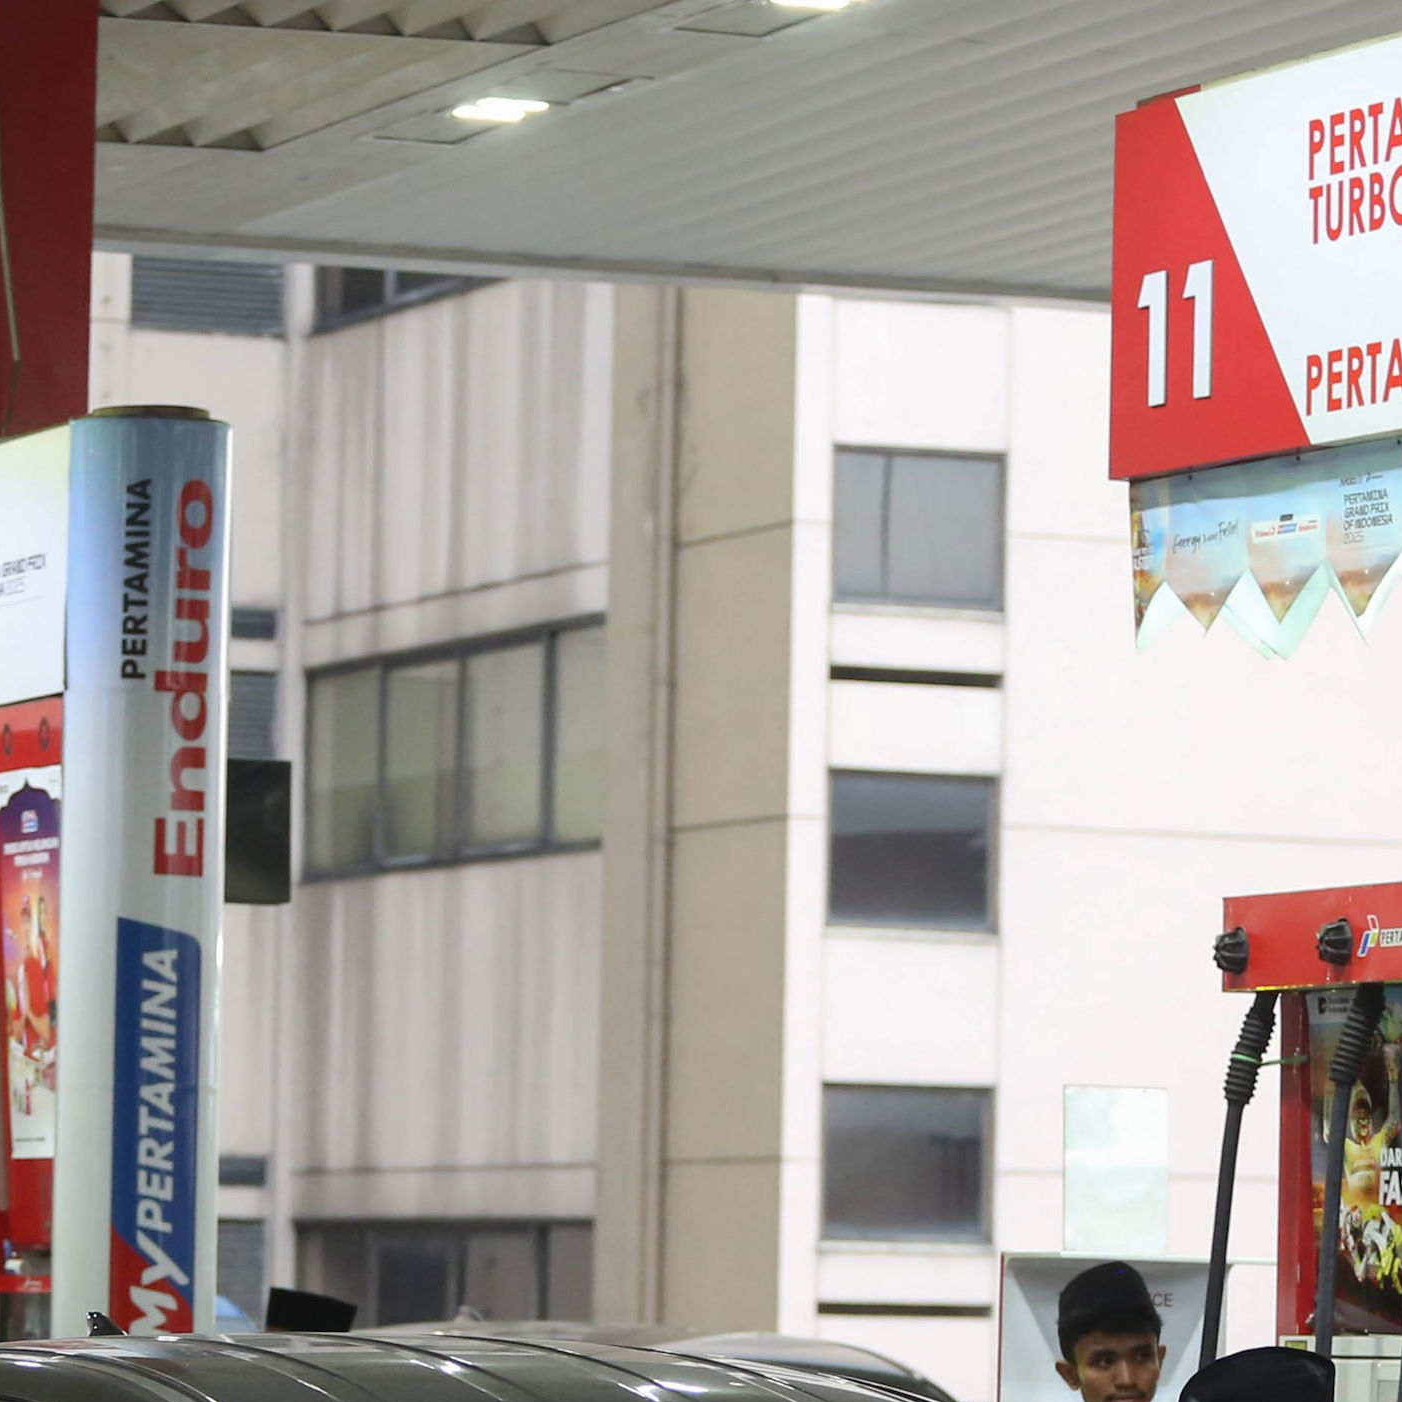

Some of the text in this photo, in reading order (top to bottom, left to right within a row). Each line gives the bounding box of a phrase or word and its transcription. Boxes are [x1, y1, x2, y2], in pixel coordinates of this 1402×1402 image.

[1136, 258, 1214, 408] 11
[121, 478, 152, 679] PERTAMINA
[154, 478, 214, 878] Enduro
[129, 949, 190, 1337] MyPERTAMINA
